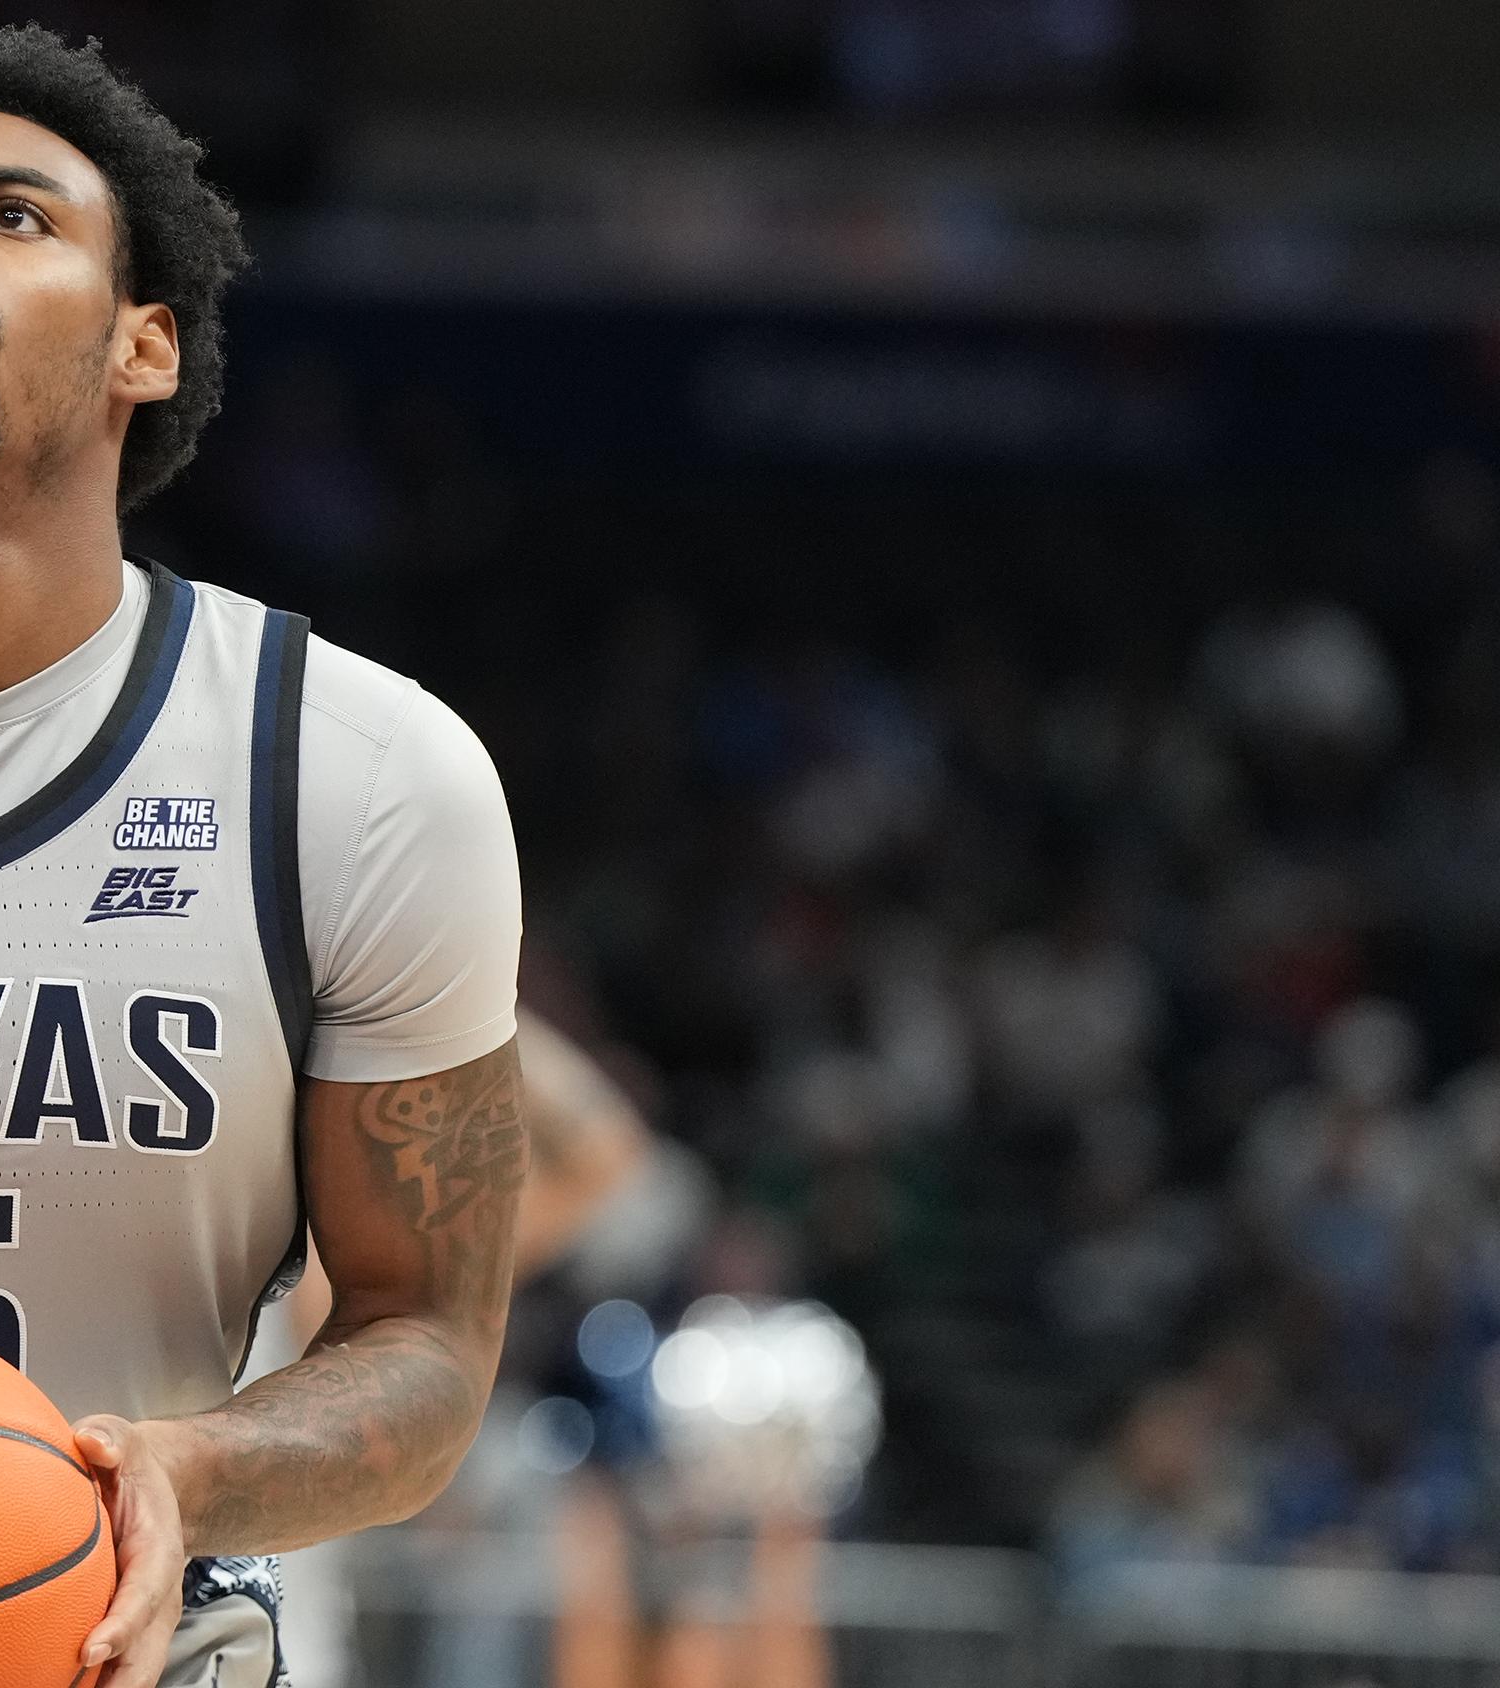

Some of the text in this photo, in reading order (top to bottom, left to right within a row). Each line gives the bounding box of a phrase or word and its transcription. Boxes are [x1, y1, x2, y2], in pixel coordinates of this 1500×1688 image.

[126, 799, 213, 823] BE THE
[115, 824, 217, 848] CHANGE
[102, 865, 180, 889] BIG
[90, 889, 199, 911] EAST
